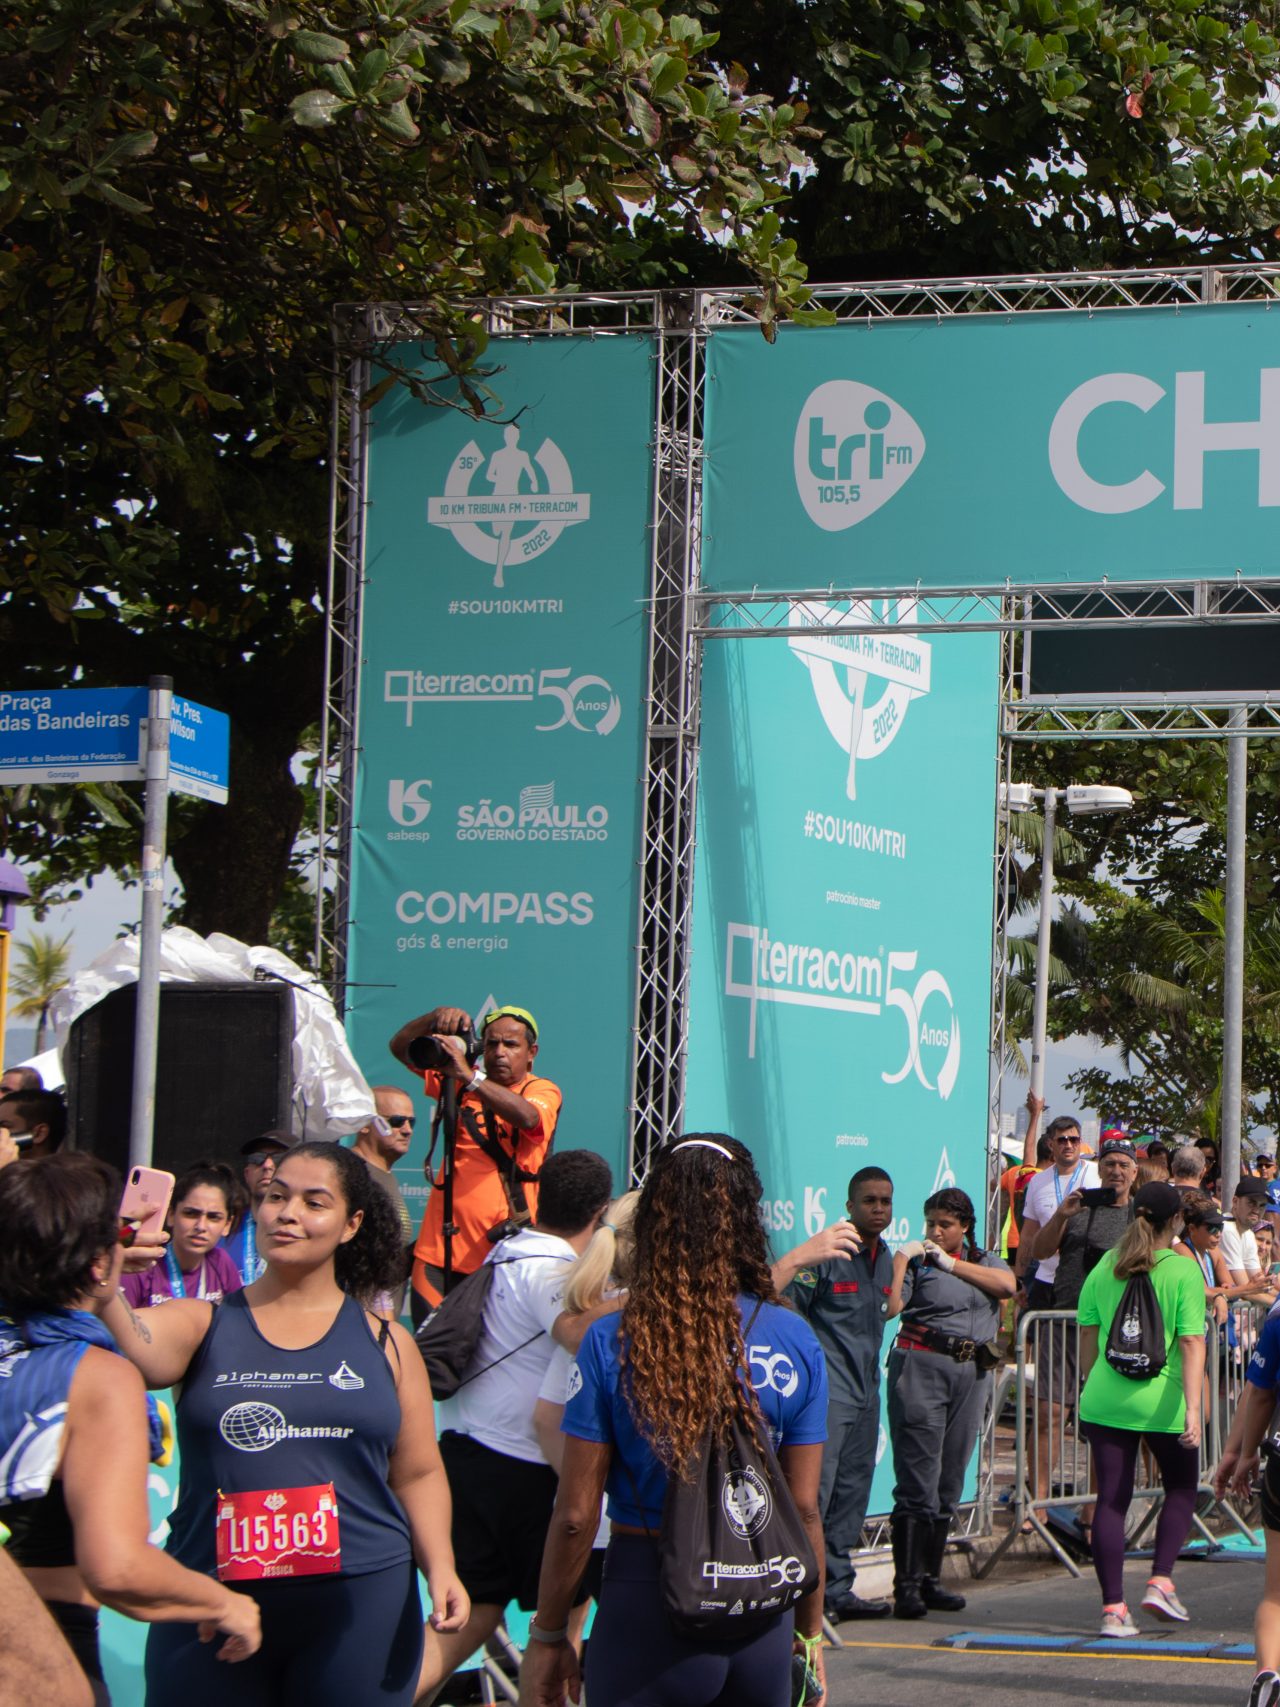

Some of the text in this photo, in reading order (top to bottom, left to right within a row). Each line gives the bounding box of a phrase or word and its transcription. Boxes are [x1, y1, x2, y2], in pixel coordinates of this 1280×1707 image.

[809, 401, 912, 481] tri FM
[817, 485, 861, 505] 105,5
[440, 501, 578, 515] 10 KM TRIBUNA FM TERRACOM
[522, 529, 552, 556] 2022
[448, 599, 563, 615] #SOU10KMTRI
[862, 636, 874, 658] FM
[880, 641, 921, 675] TERRACOM
[1, 694, 52, 714] Praça
[171, 698, 203, 724] Av. Pres.
[414, 666, 622, 736] terracom 50
[575, 699, 608, 712] Anos
[0, 711, 130, 732] das Bandeiras
[170, 718, 196, 742] Wilson
[872, 698, 899, 745] 2022
[457, 799, 608, 828] SÃO PAULO
[387, 829, 430, 843] sabesp
[456, 829, 608, 841] GOVERNO DO ESTADO
[804, 810, 906, 859] #SOU10KMTRI
[396, 890, 594, 925] COMPASS
[397, 934, 508, 953] gás & energia
[759, 928, 960, 1101] terracom 50
[920, 1022, 949, 1048] Anos
[216, 1371, 322, 1383] alphamar
[256, 1424, 354, 1442] Alphamar
[229, 1511, 328, 1553] L15563
[262, 1565, 295, 1577] JESSICA
[717, 1561, 768, 1575] terracom
